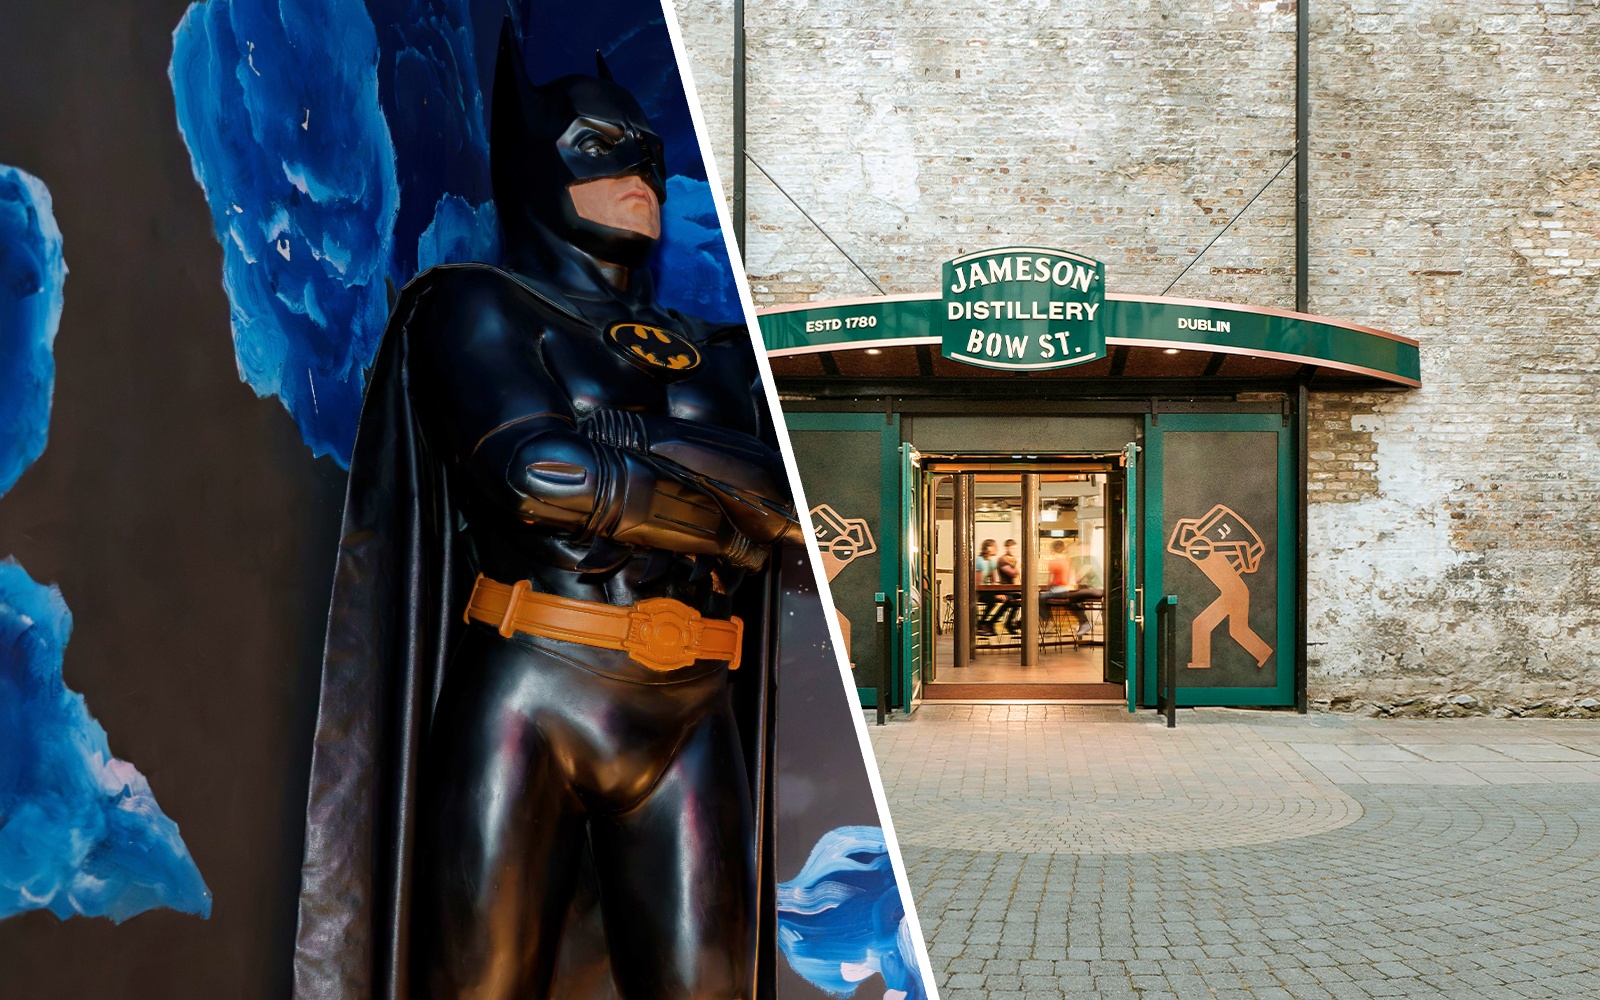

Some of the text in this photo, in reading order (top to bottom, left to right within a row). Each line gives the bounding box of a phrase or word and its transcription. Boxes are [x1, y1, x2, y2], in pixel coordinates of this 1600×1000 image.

[951, 256, 1097, 294] JAMESON
[947, 301, 1099, 321] DISTILLERY
[805, 315, 877, 333] ESTD 1780
[1177, 317, 1231, 333] DUBLIN
[966, 328, 1082, 359] BOW ST.
